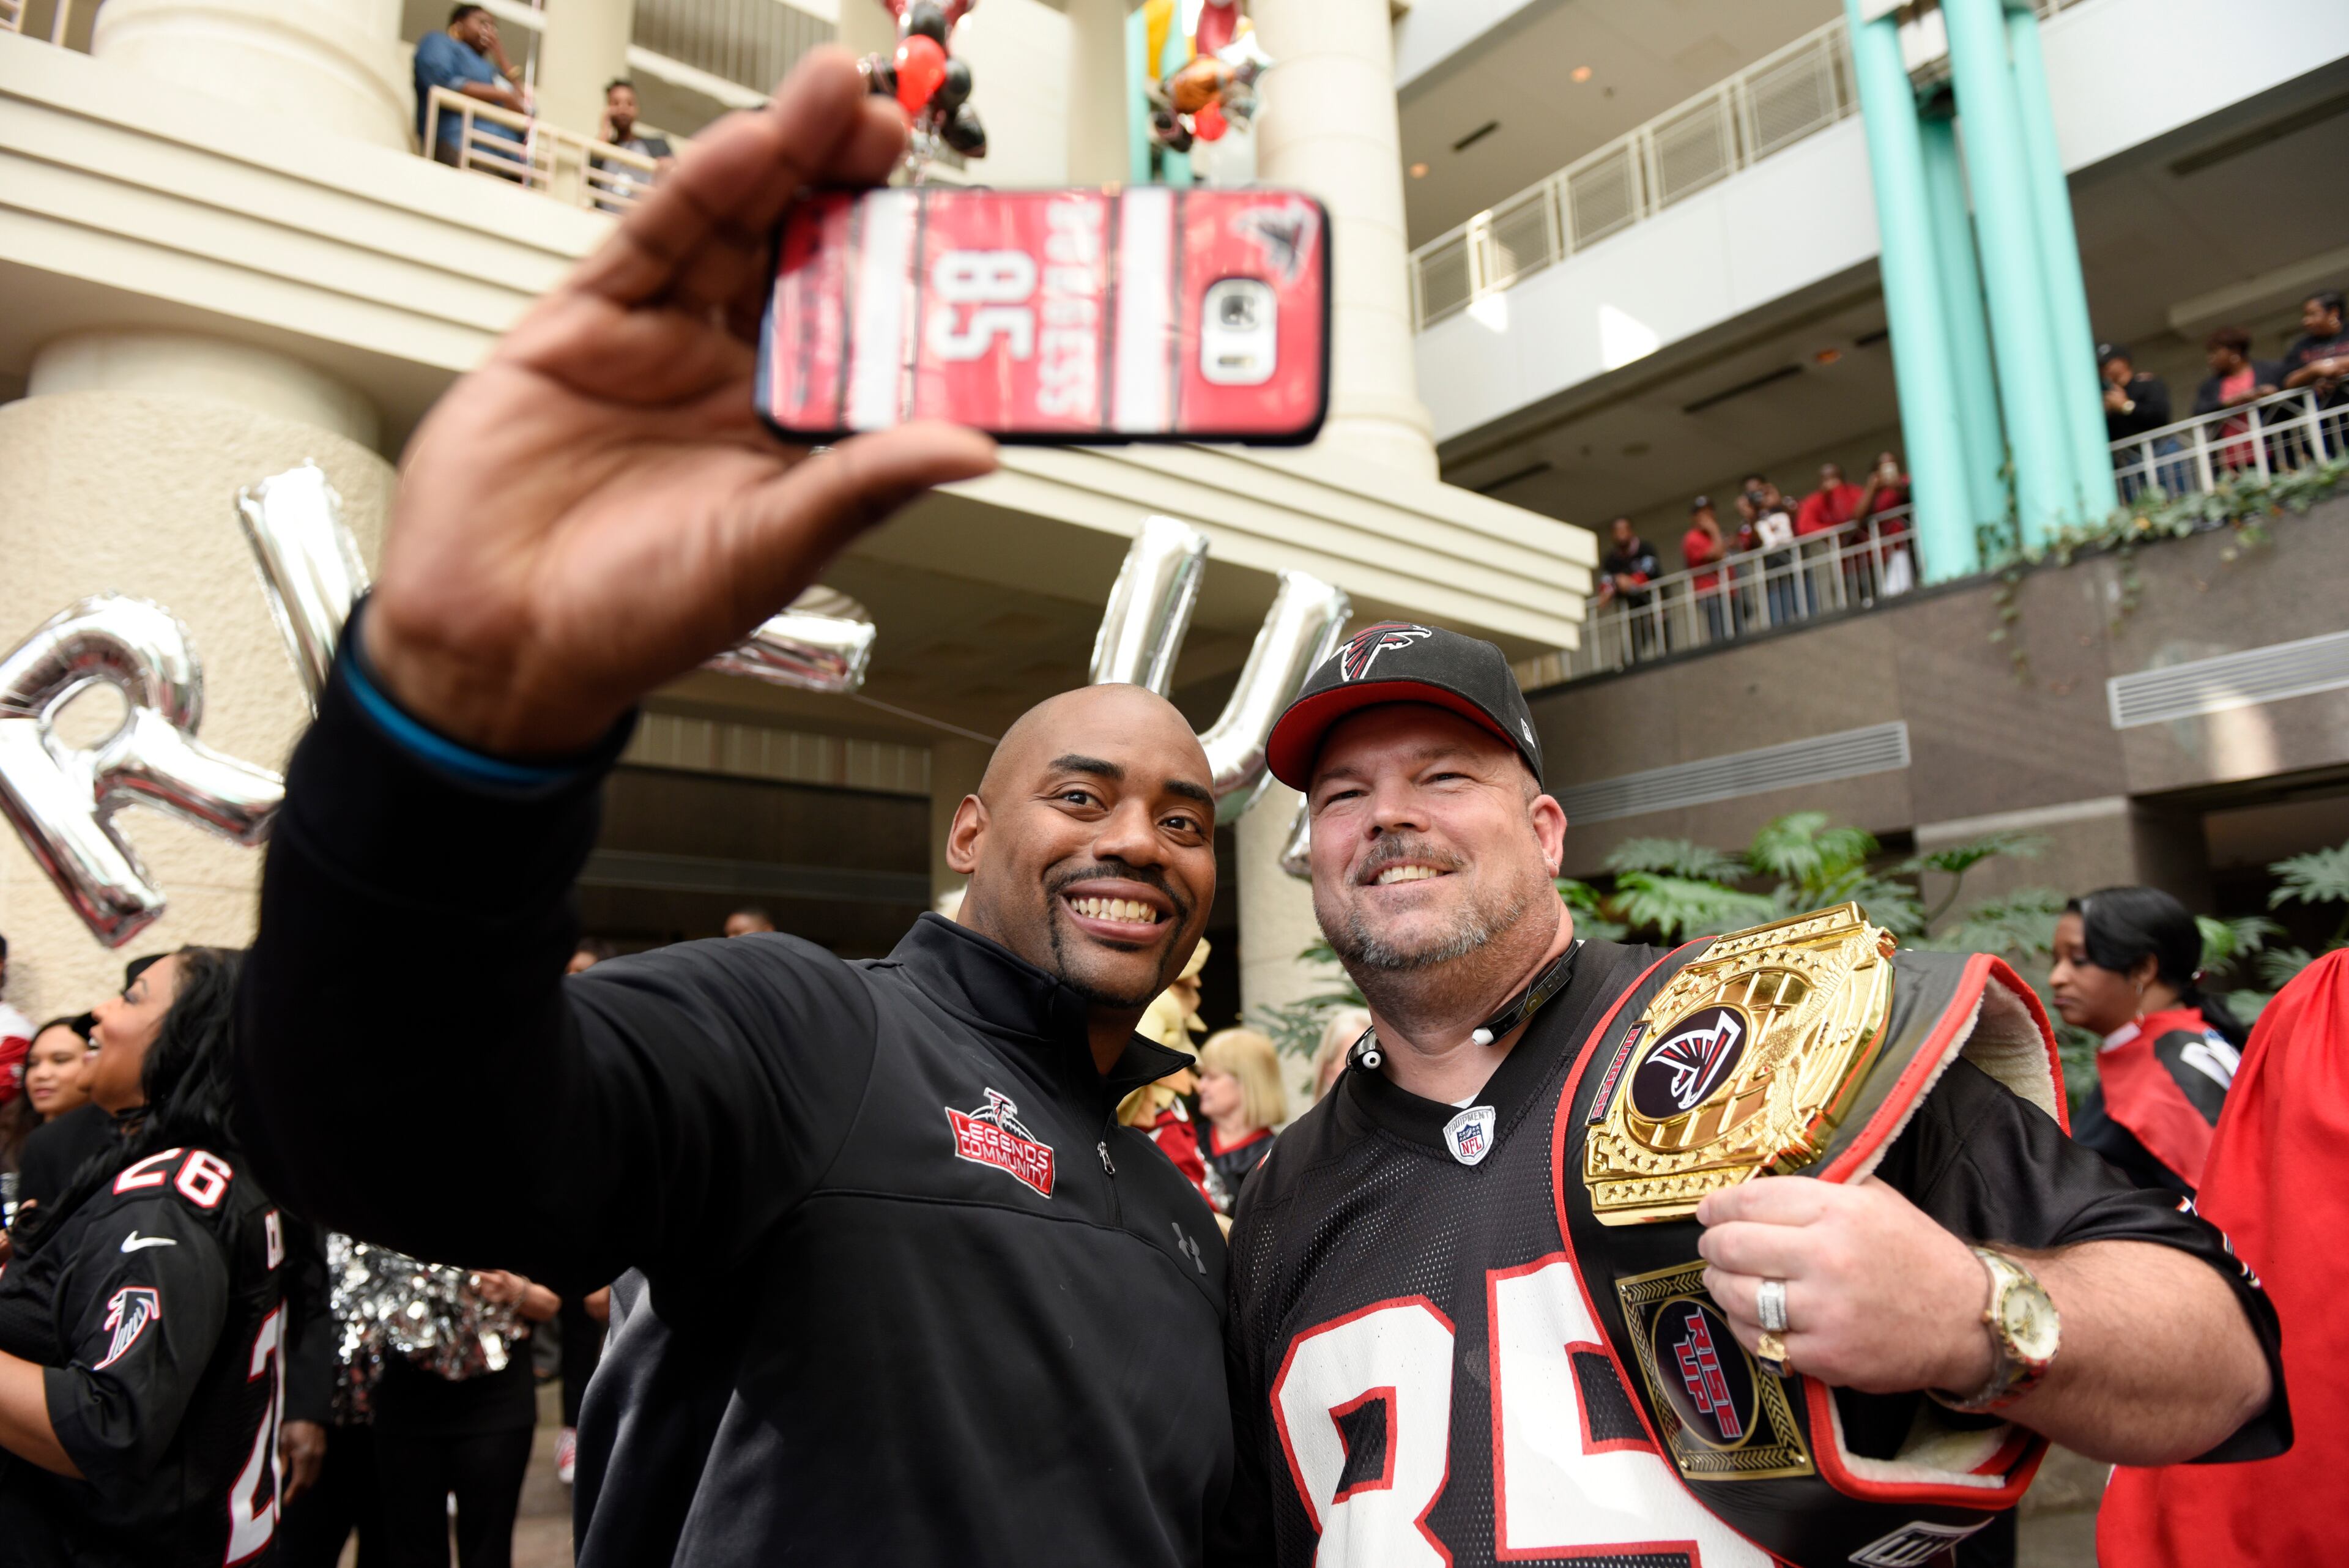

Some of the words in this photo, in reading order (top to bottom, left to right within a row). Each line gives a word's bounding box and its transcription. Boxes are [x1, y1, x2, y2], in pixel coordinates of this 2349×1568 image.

[929, 248, 1037, 360] 85
[1591, 1026, 1642, 1119] BURGESS
[954, 1115, 1049, 1170] LEGENDS
[1448, 1110, 1490, 1137] EQUIPMENT
[1460, 1136, 1482, 1155] NFL
[113, 1147, 234, 1209] 26
[960, 1135, 1047, 1187] COMMUNITY
[1672, 1333, 1713, 1413] UP
[1684, 1305, 1743, 1438] RISE
